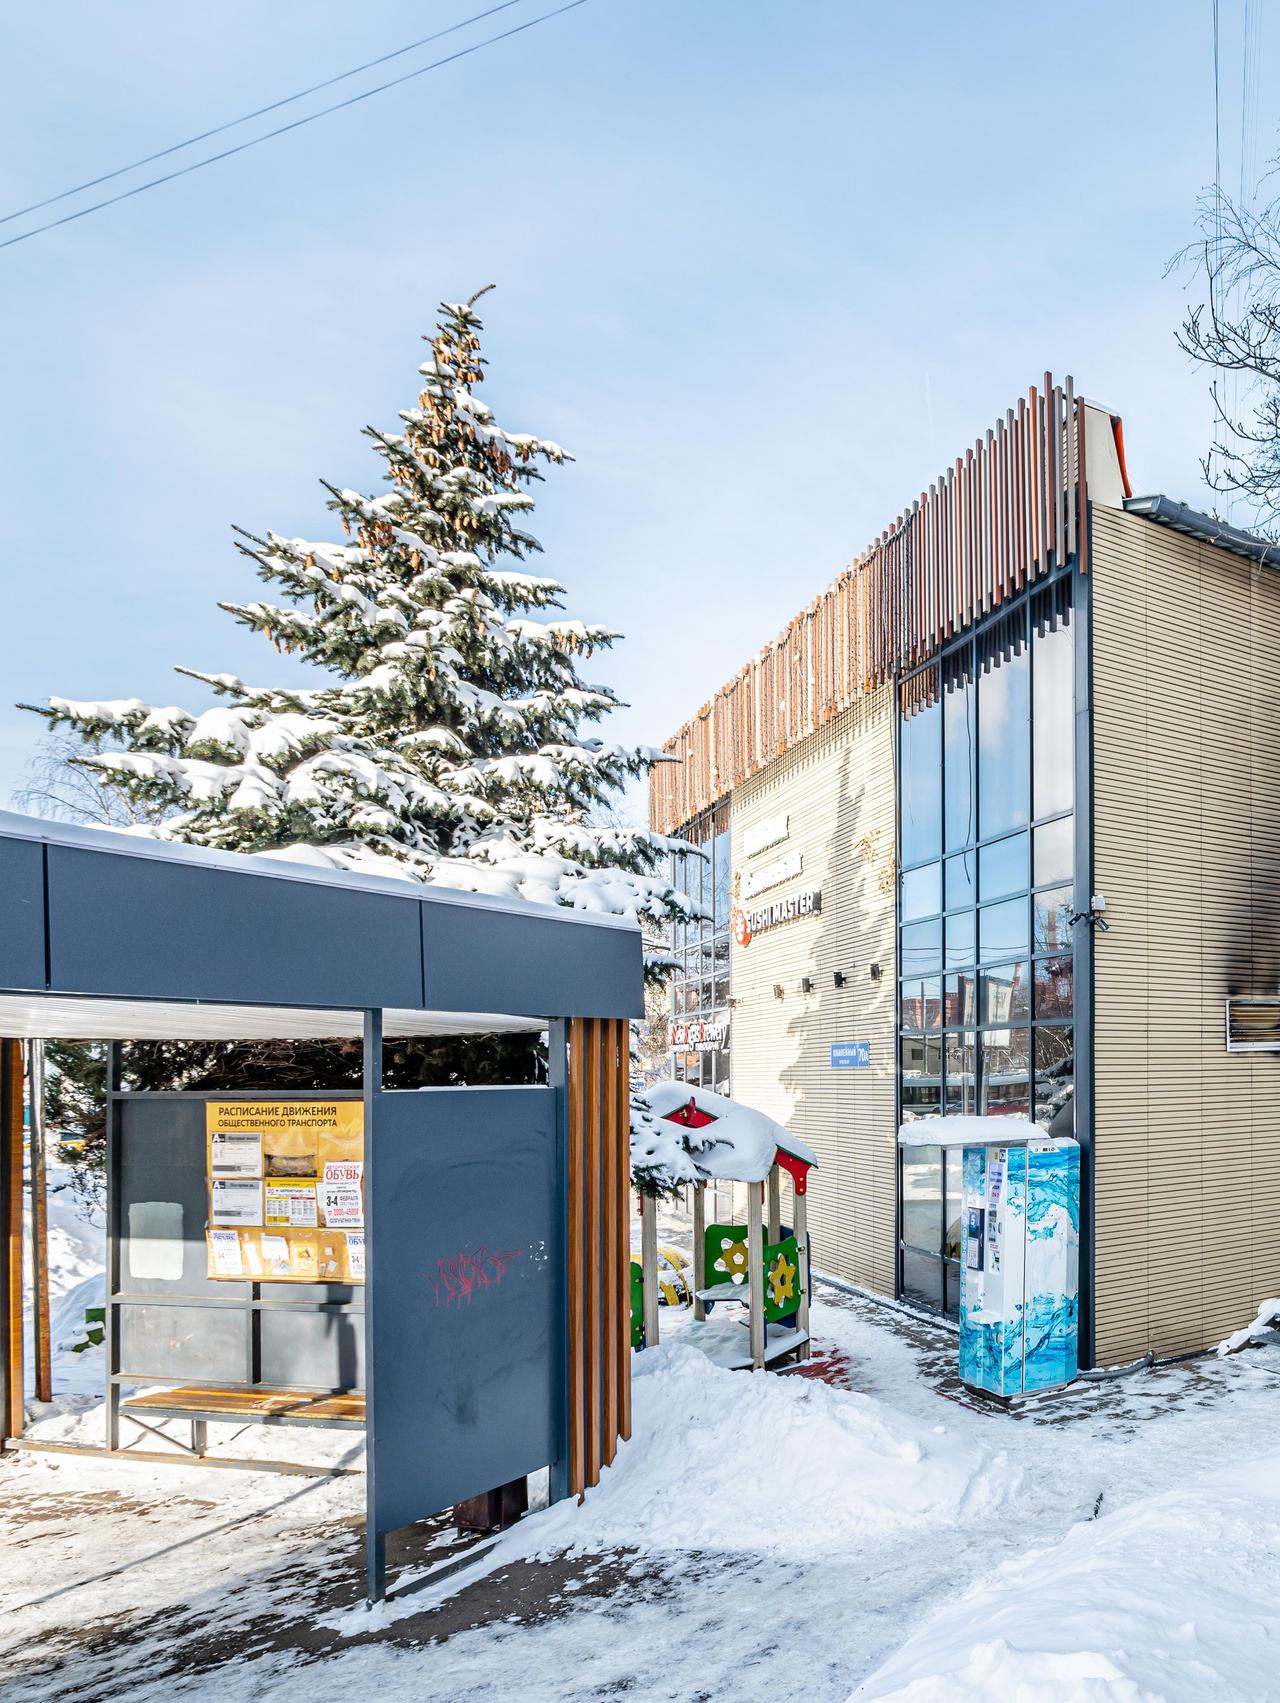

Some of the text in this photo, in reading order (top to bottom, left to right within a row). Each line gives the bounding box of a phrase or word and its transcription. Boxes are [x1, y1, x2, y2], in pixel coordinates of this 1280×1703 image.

[747, 892, 814, 934] SUSHI MASTER
[219, 1106, 337, 1117] РАСПИСАНИЕ ДВИЖЕНИЯ
[218, 1119, 338, 1128] ОБЩЕСТВЕННОГО ТРАНСПОРТА
[325, 1169, 360, 1180] ОБУВЬ
[326, 1195, 338, 1207] 3-4
[970, 1214, 976, 1226] 5
